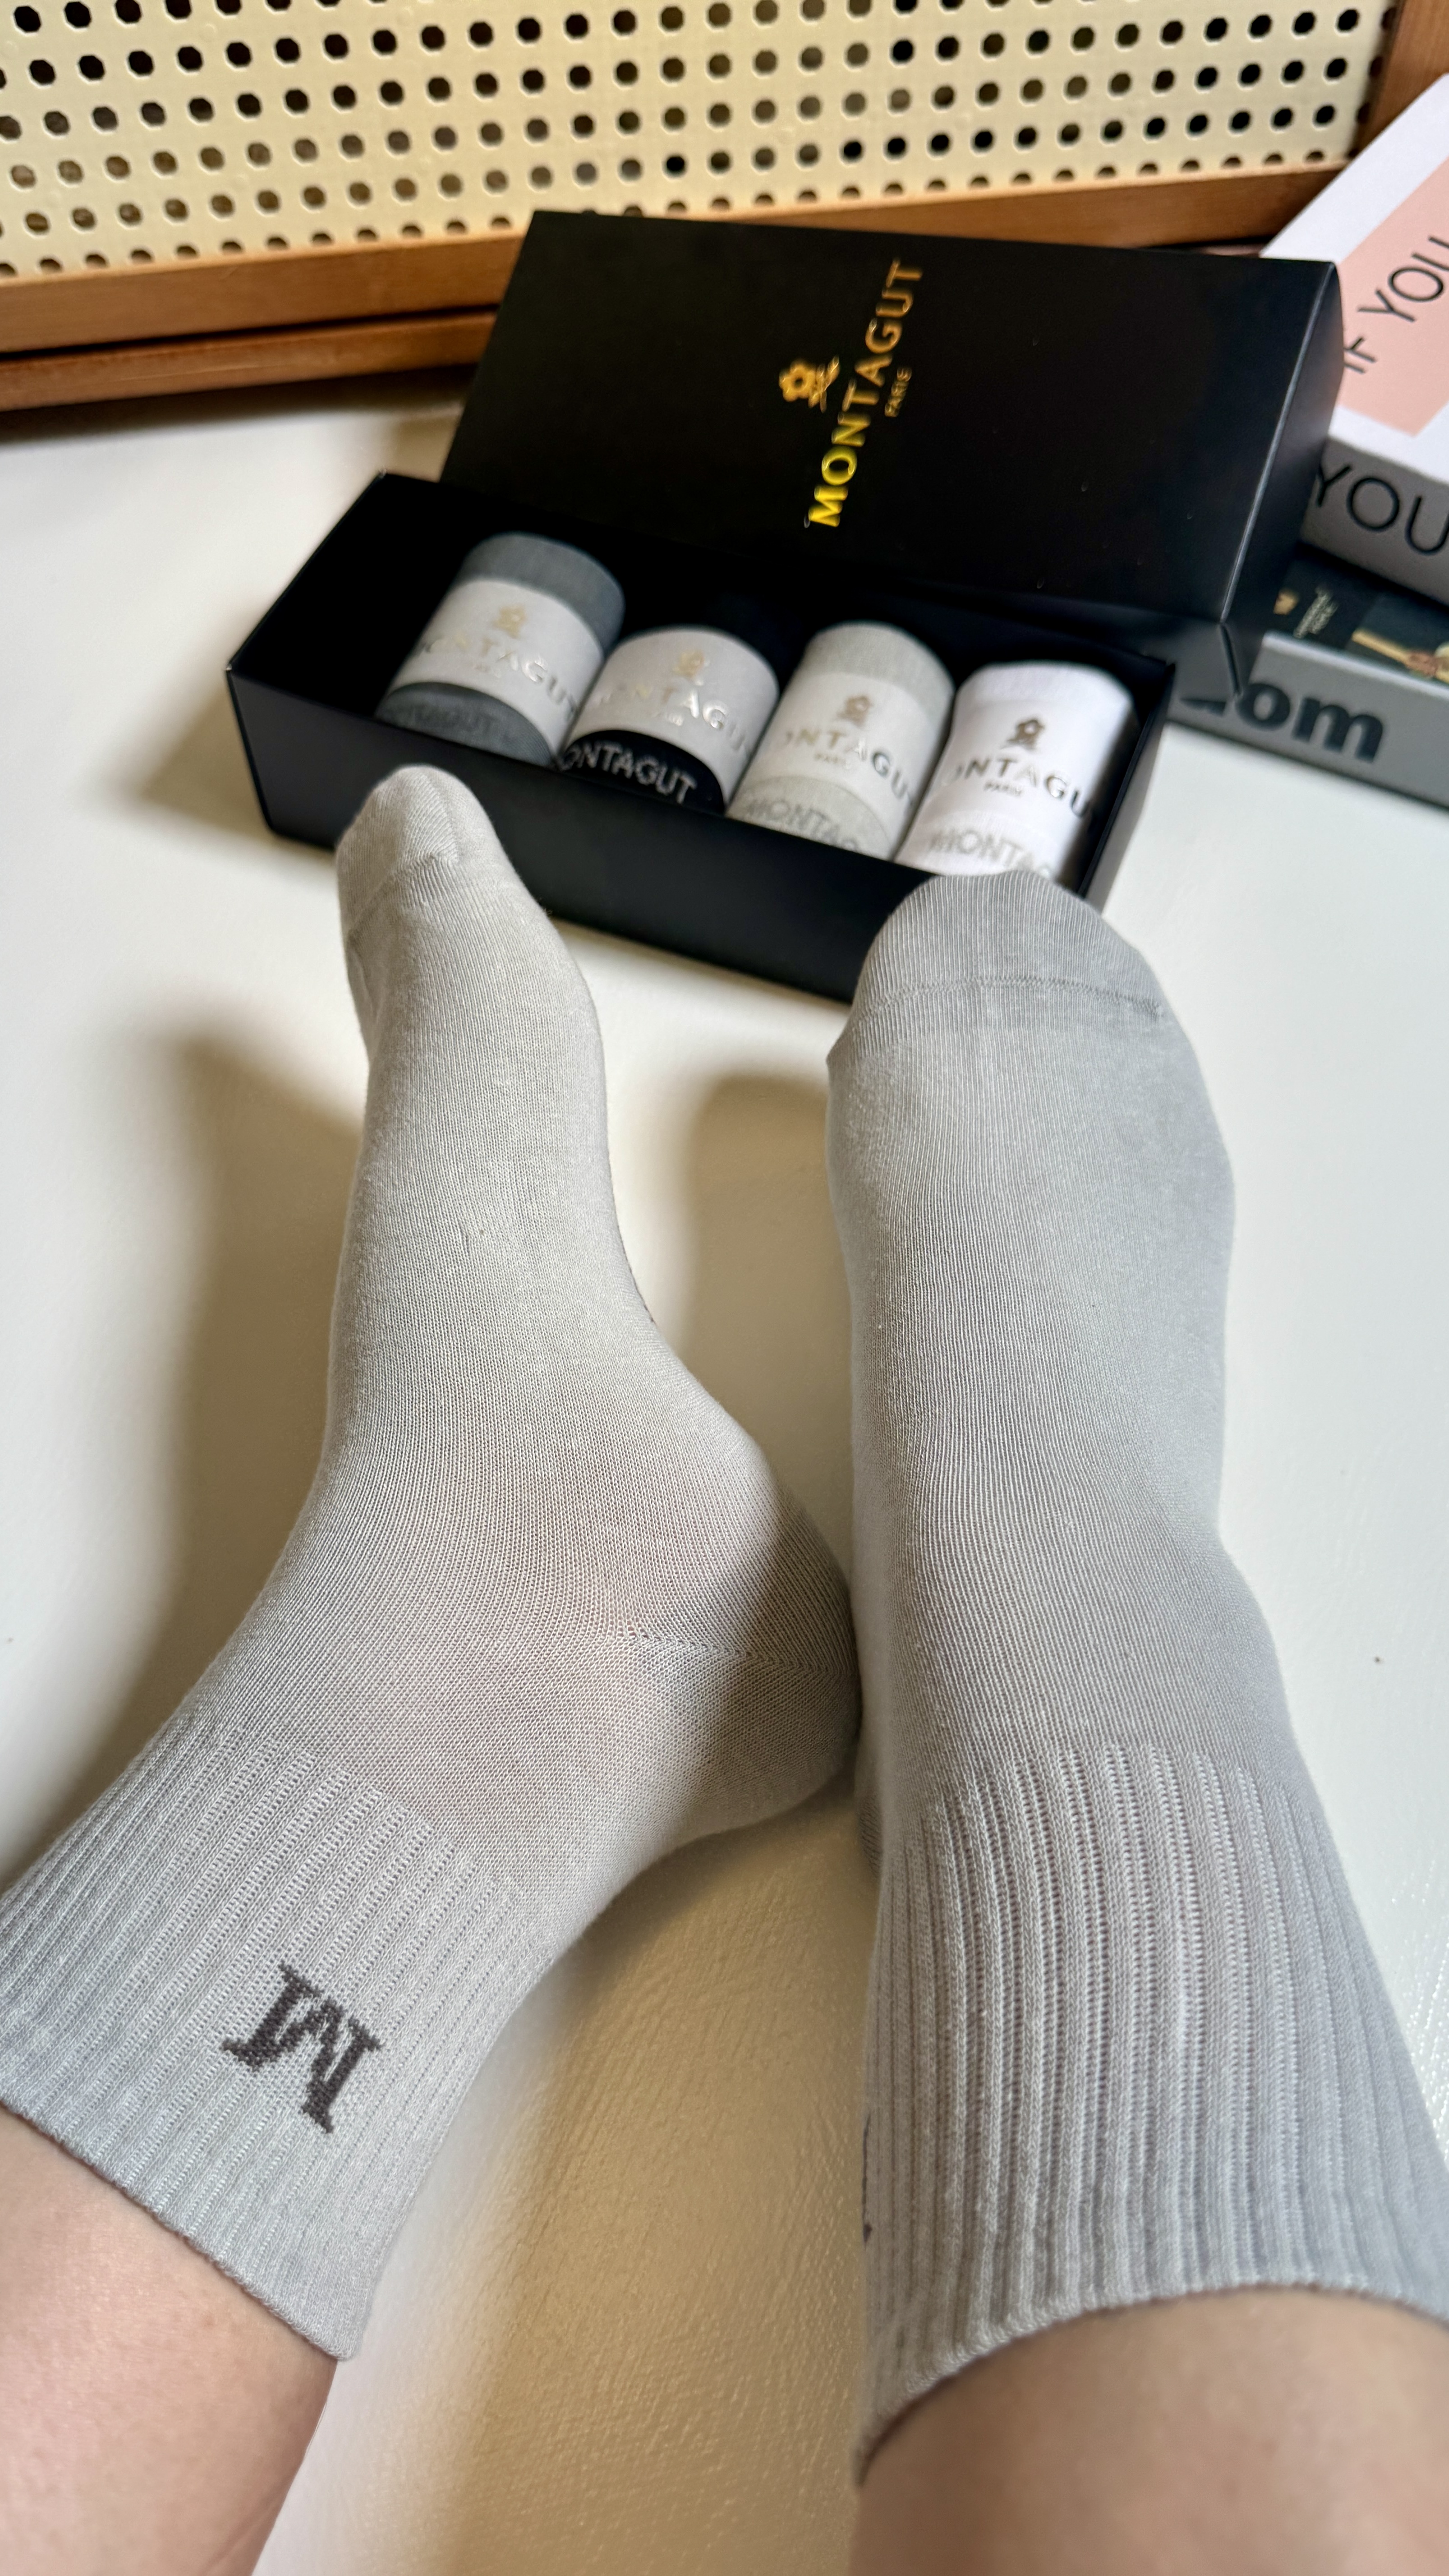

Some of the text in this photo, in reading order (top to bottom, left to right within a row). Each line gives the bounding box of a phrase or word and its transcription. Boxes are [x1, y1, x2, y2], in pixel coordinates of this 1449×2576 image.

[804, 257, 923, 528] MONTAGUT
[884, 367, 912, 418] PARIS
[1316, 464, 1449, 556] YOU
[1179, 682, 1384, 763] om
